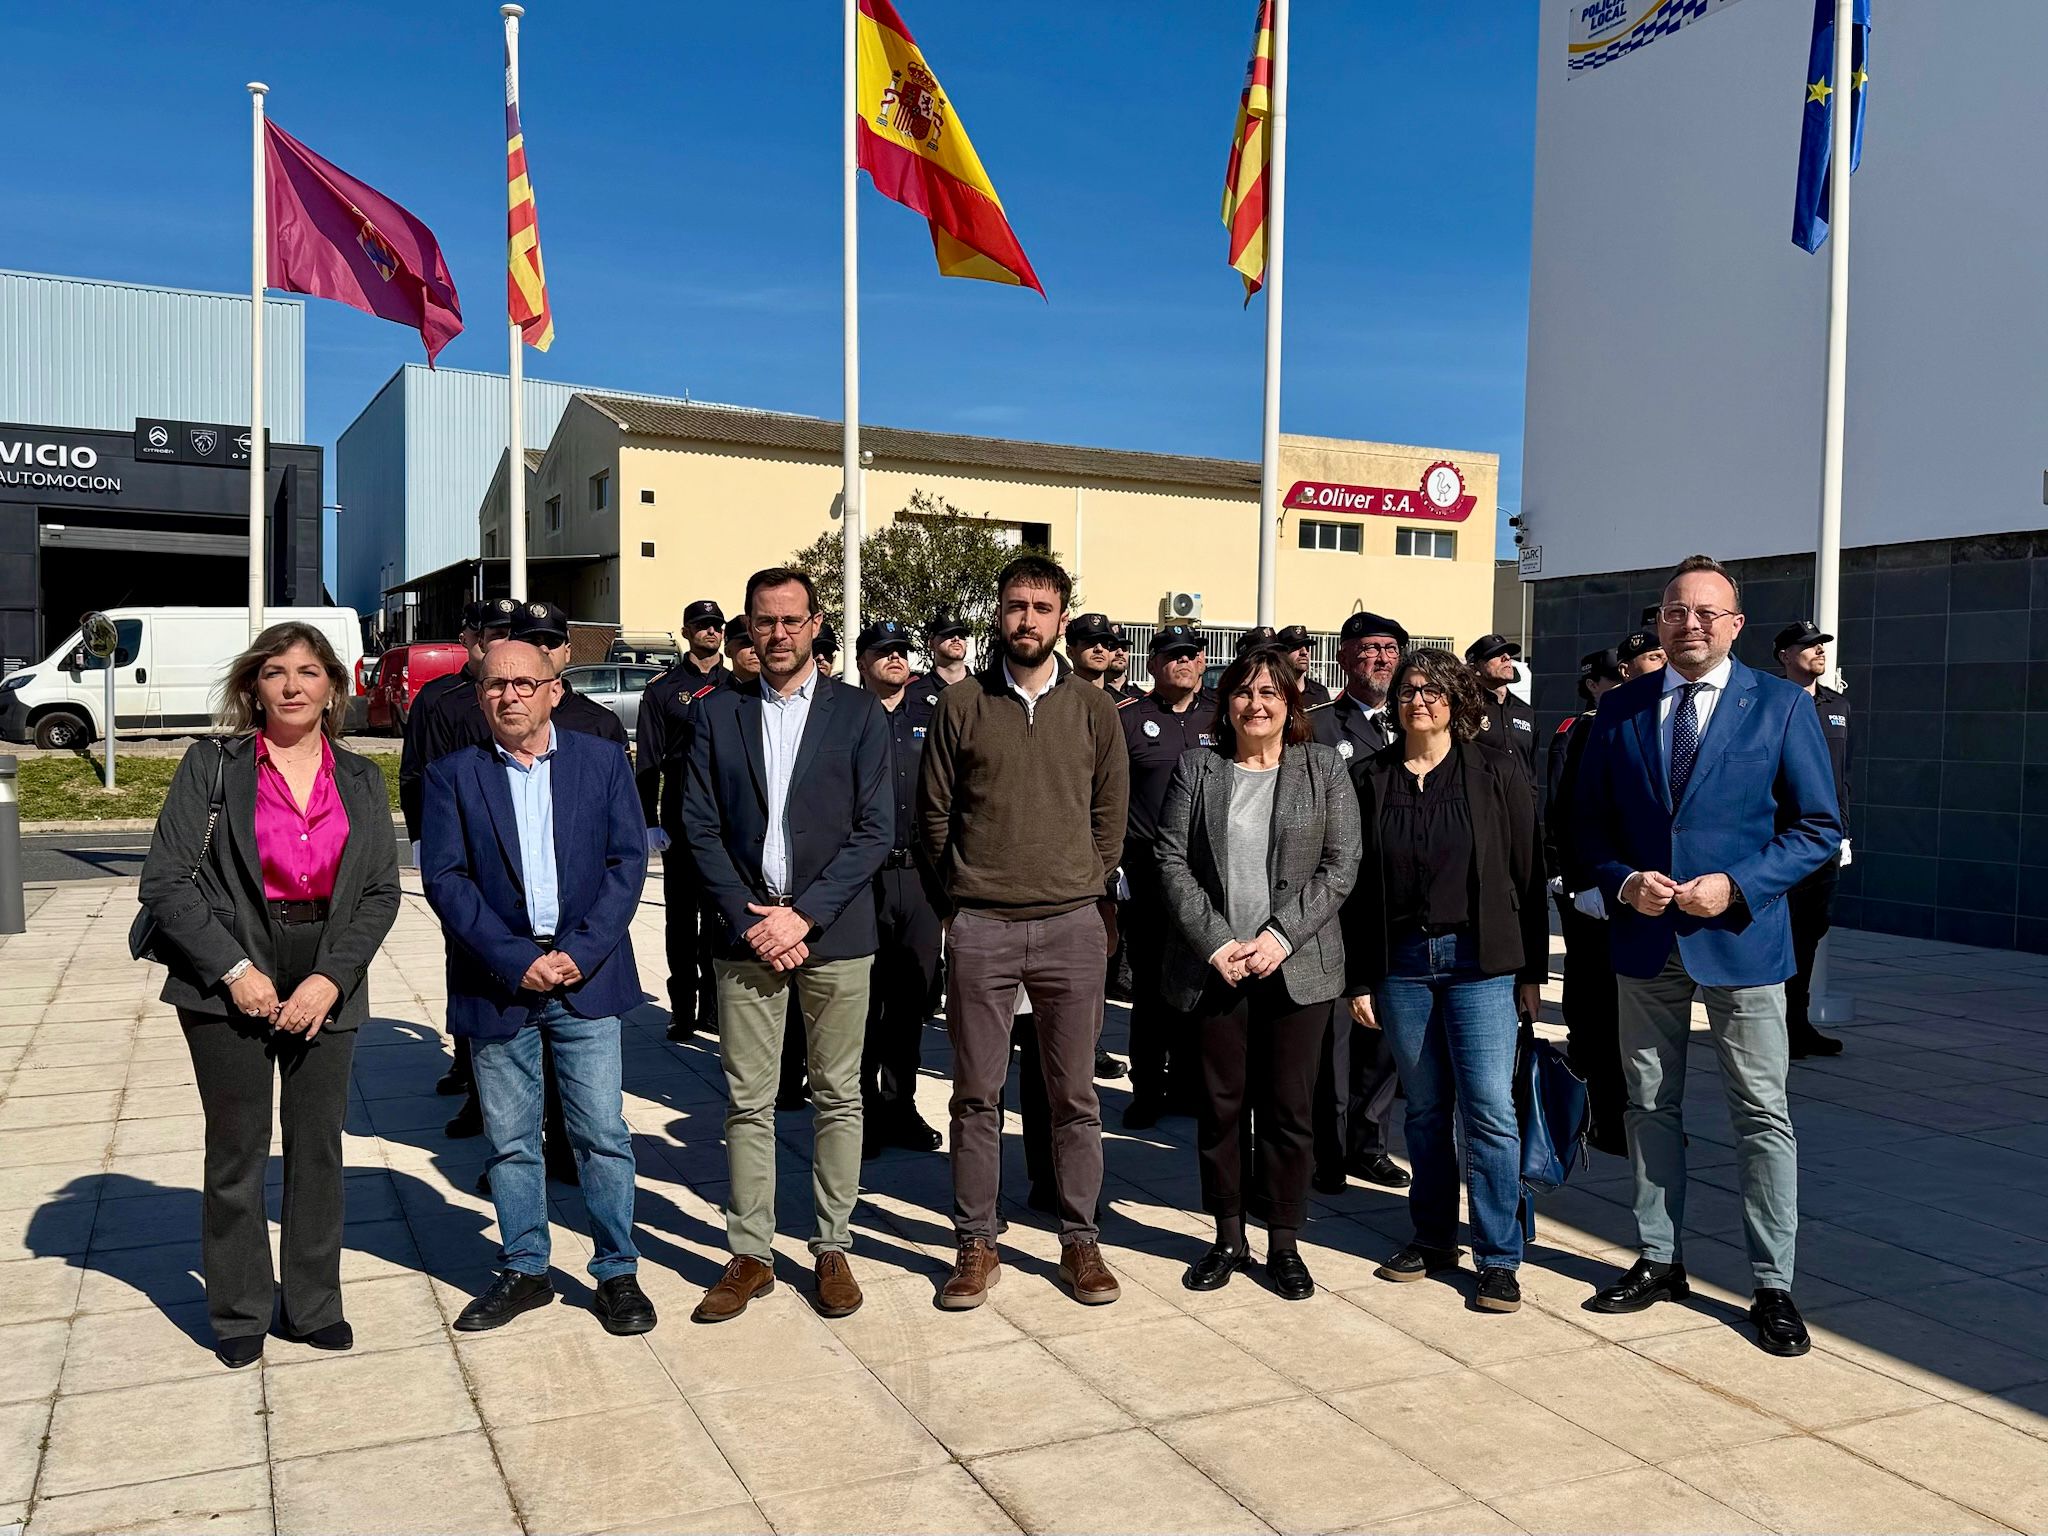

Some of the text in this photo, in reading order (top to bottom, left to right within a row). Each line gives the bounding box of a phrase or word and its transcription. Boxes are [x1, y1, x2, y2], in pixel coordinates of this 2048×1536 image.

[1590, 3, 1627, 31] LOCAL
[0, 441, 98, 469] VICIO
[1381, 493, 1415, 513] S.A.
